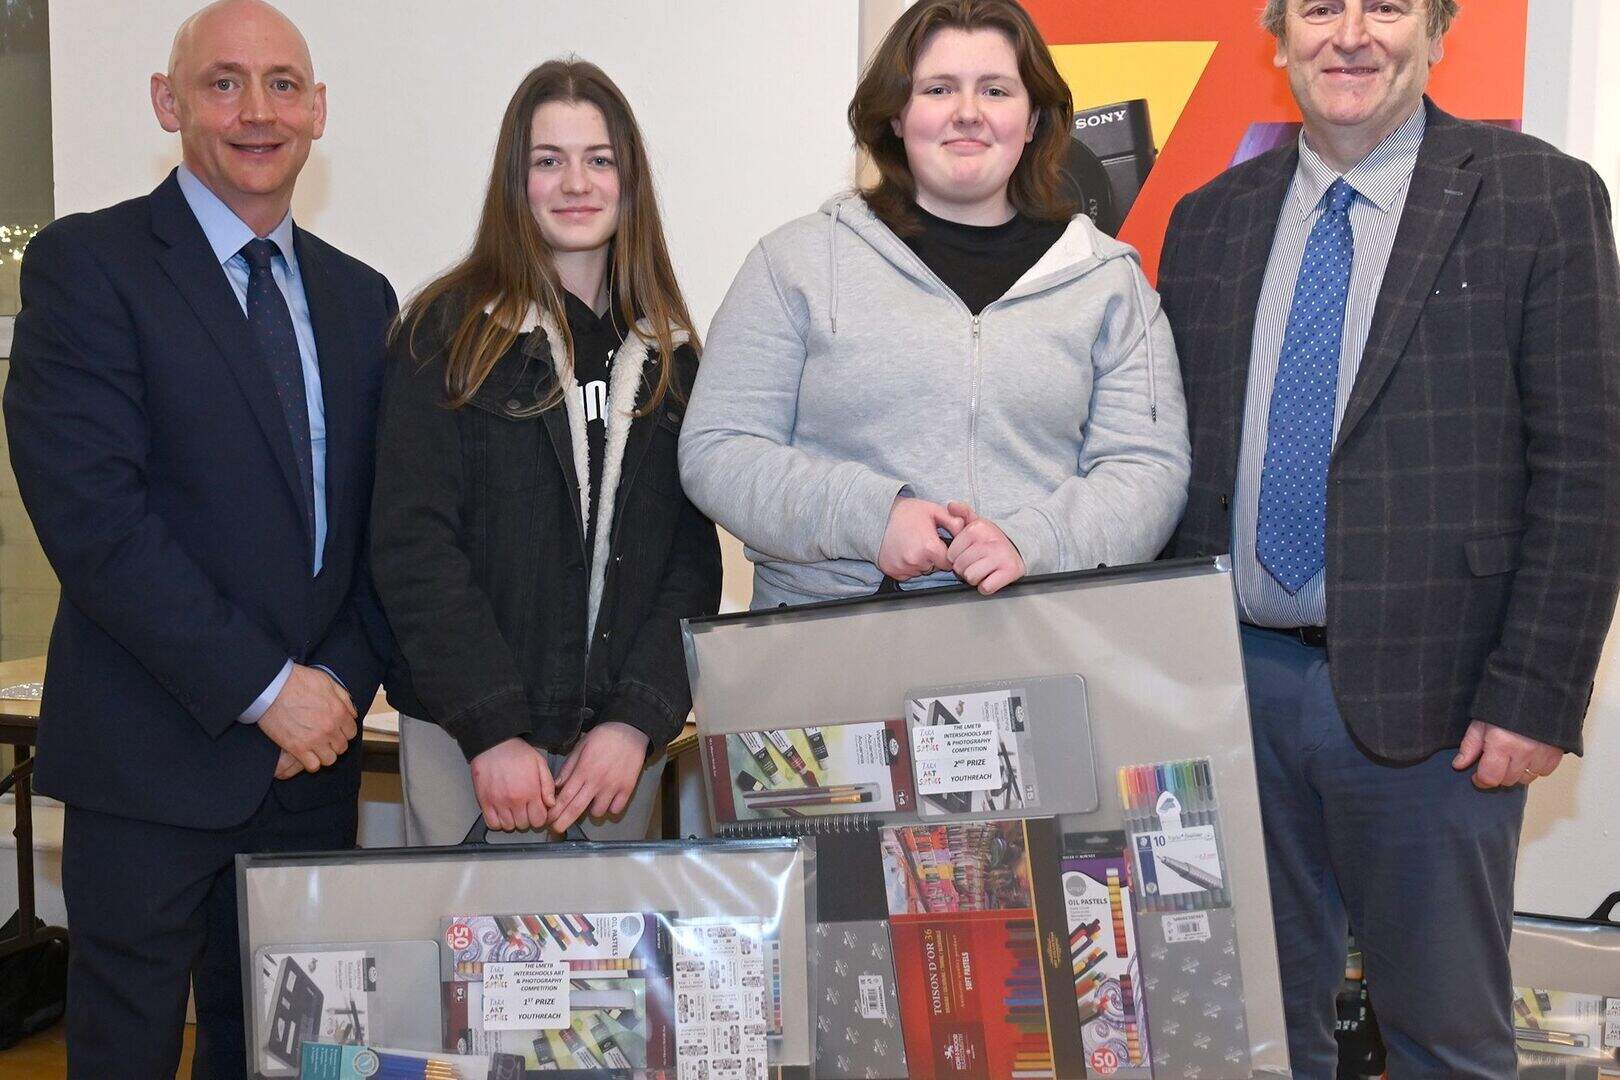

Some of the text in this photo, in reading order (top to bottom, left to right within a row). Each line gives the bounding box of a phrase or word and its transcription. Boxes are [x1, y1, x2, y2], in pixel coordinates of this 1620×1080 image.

[1075, 109, 1127, 130] SONY
[943, 731, 981, 739] INTERSCHOOLS
[952, 738, 991, 746] PHOTOGRAPHY
[951, 746, 988, 754] COMPETITION
[966, 759, 986, 767] PRIZE
[950, 773, 993, 782] YOUTHREACH
[1153, 834, 1166, 847] 10
[1080, 897, 1108, 905] PASTELS
[453, 925, 469, 948] 50
[923, 928, 942, 1016] TOISON D'OR 36
[961, 951, 973, 991] SOFT PASTELS
[535, 998, 556, 1006] PRIZE
[518, 1012, 562, 1020] YOUTHREACH
[1093, 1052, 1116, 1067] 50
